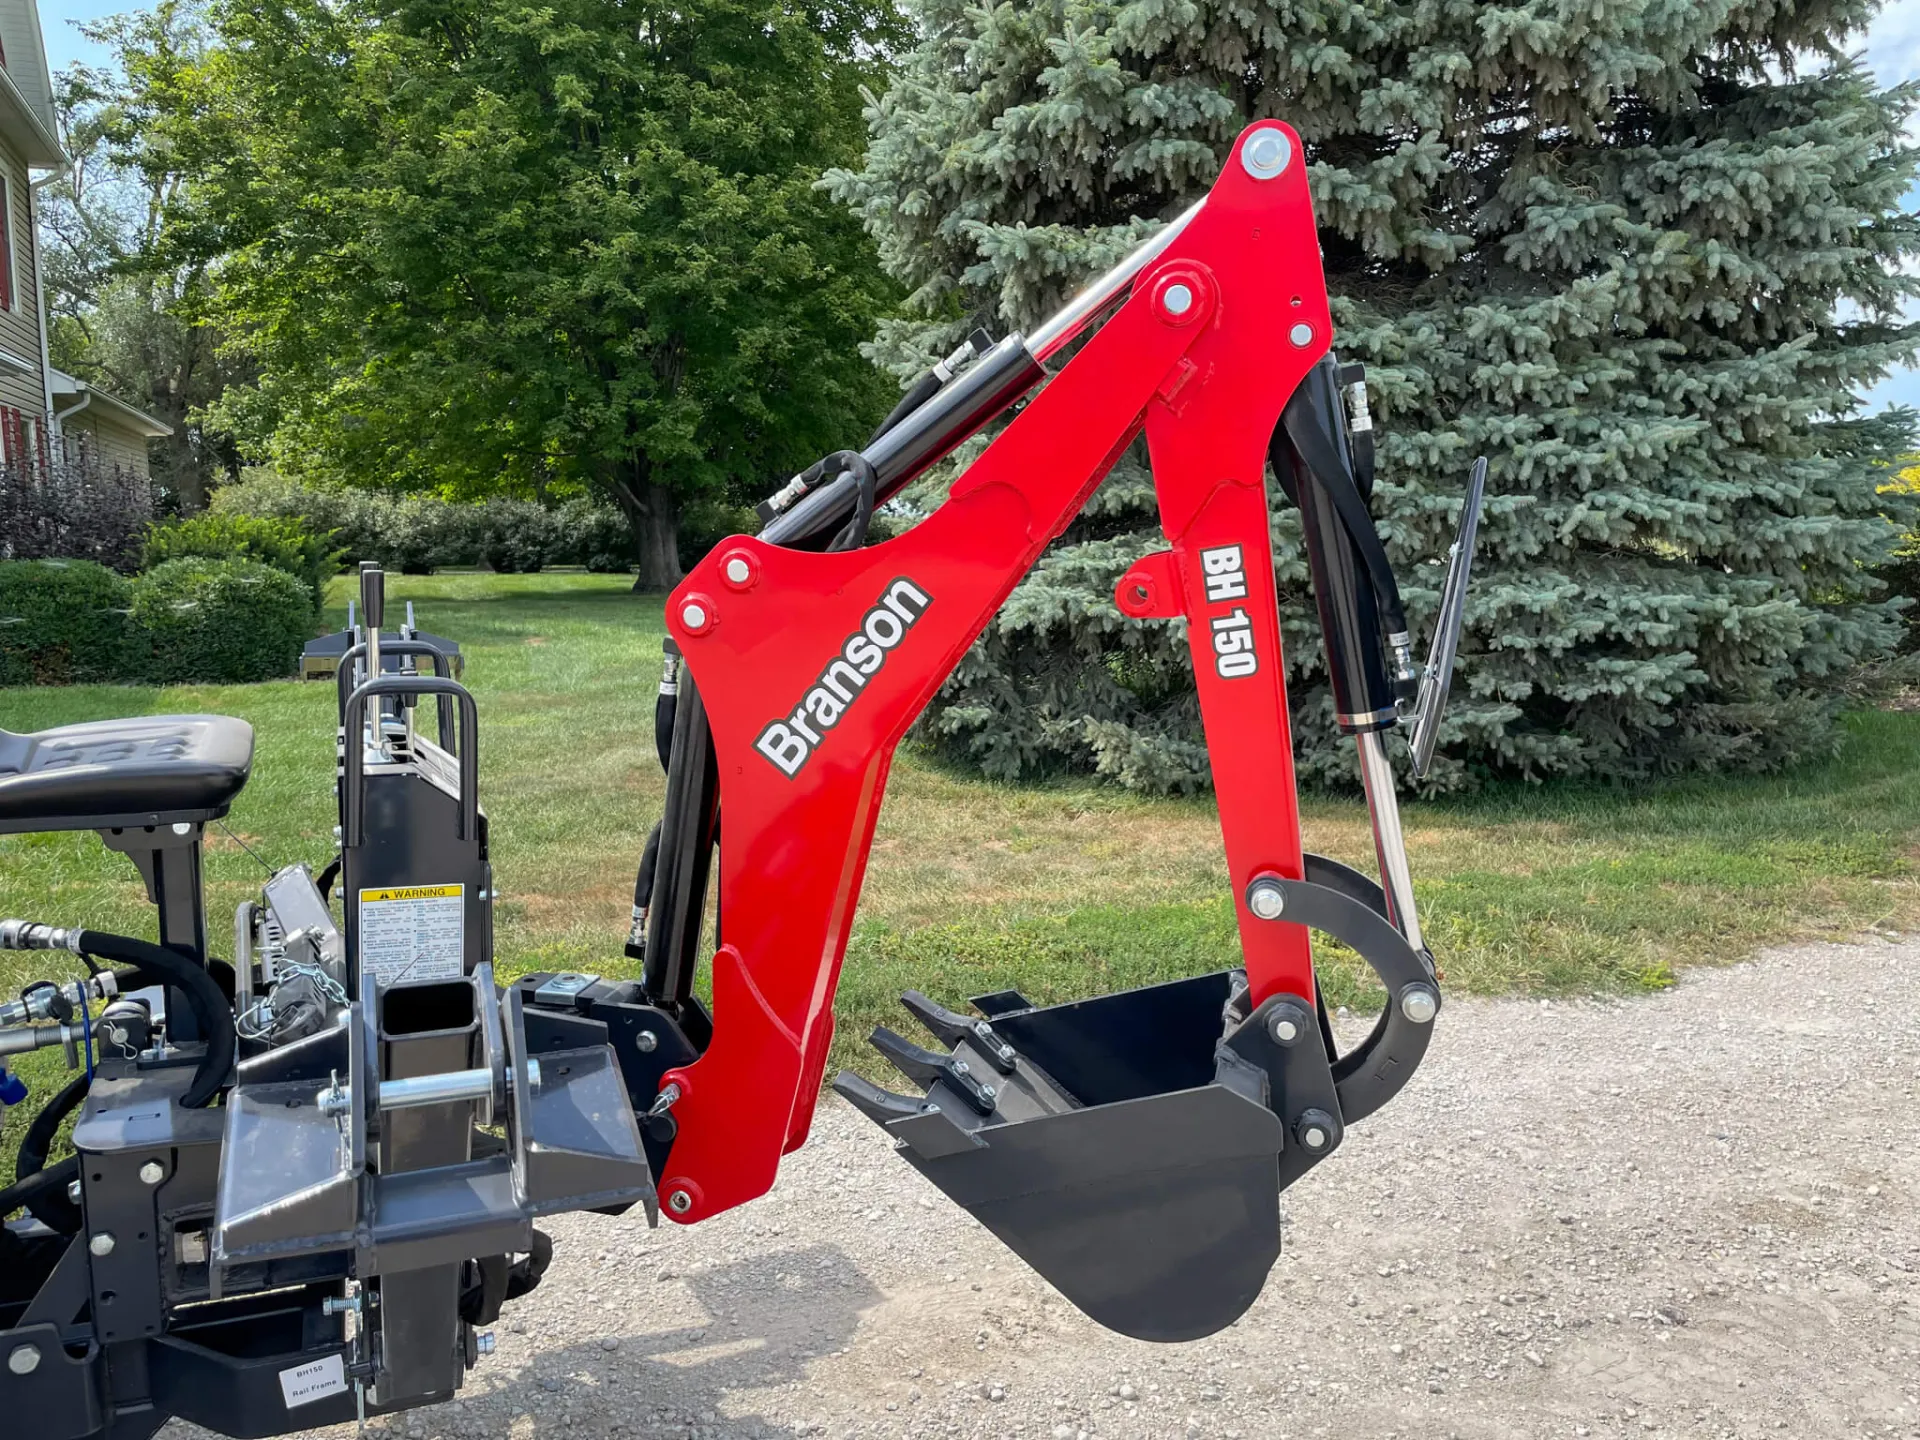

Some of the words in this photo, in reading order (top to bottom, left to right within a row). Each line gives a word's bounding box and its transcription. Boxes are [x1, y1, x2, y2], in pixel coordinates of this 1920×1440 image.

[1201, 544, 1248, 602] BH
[1211, 607, 1258, 678] 150
[754, 577, 931, 778] Branson
[394, 888, 445, 898] WARNING
[292, 1386, 309, 1397] Rail
[311, 1380, 337, 1391] Frame
[297, 1365, 323, 1377] BH150
